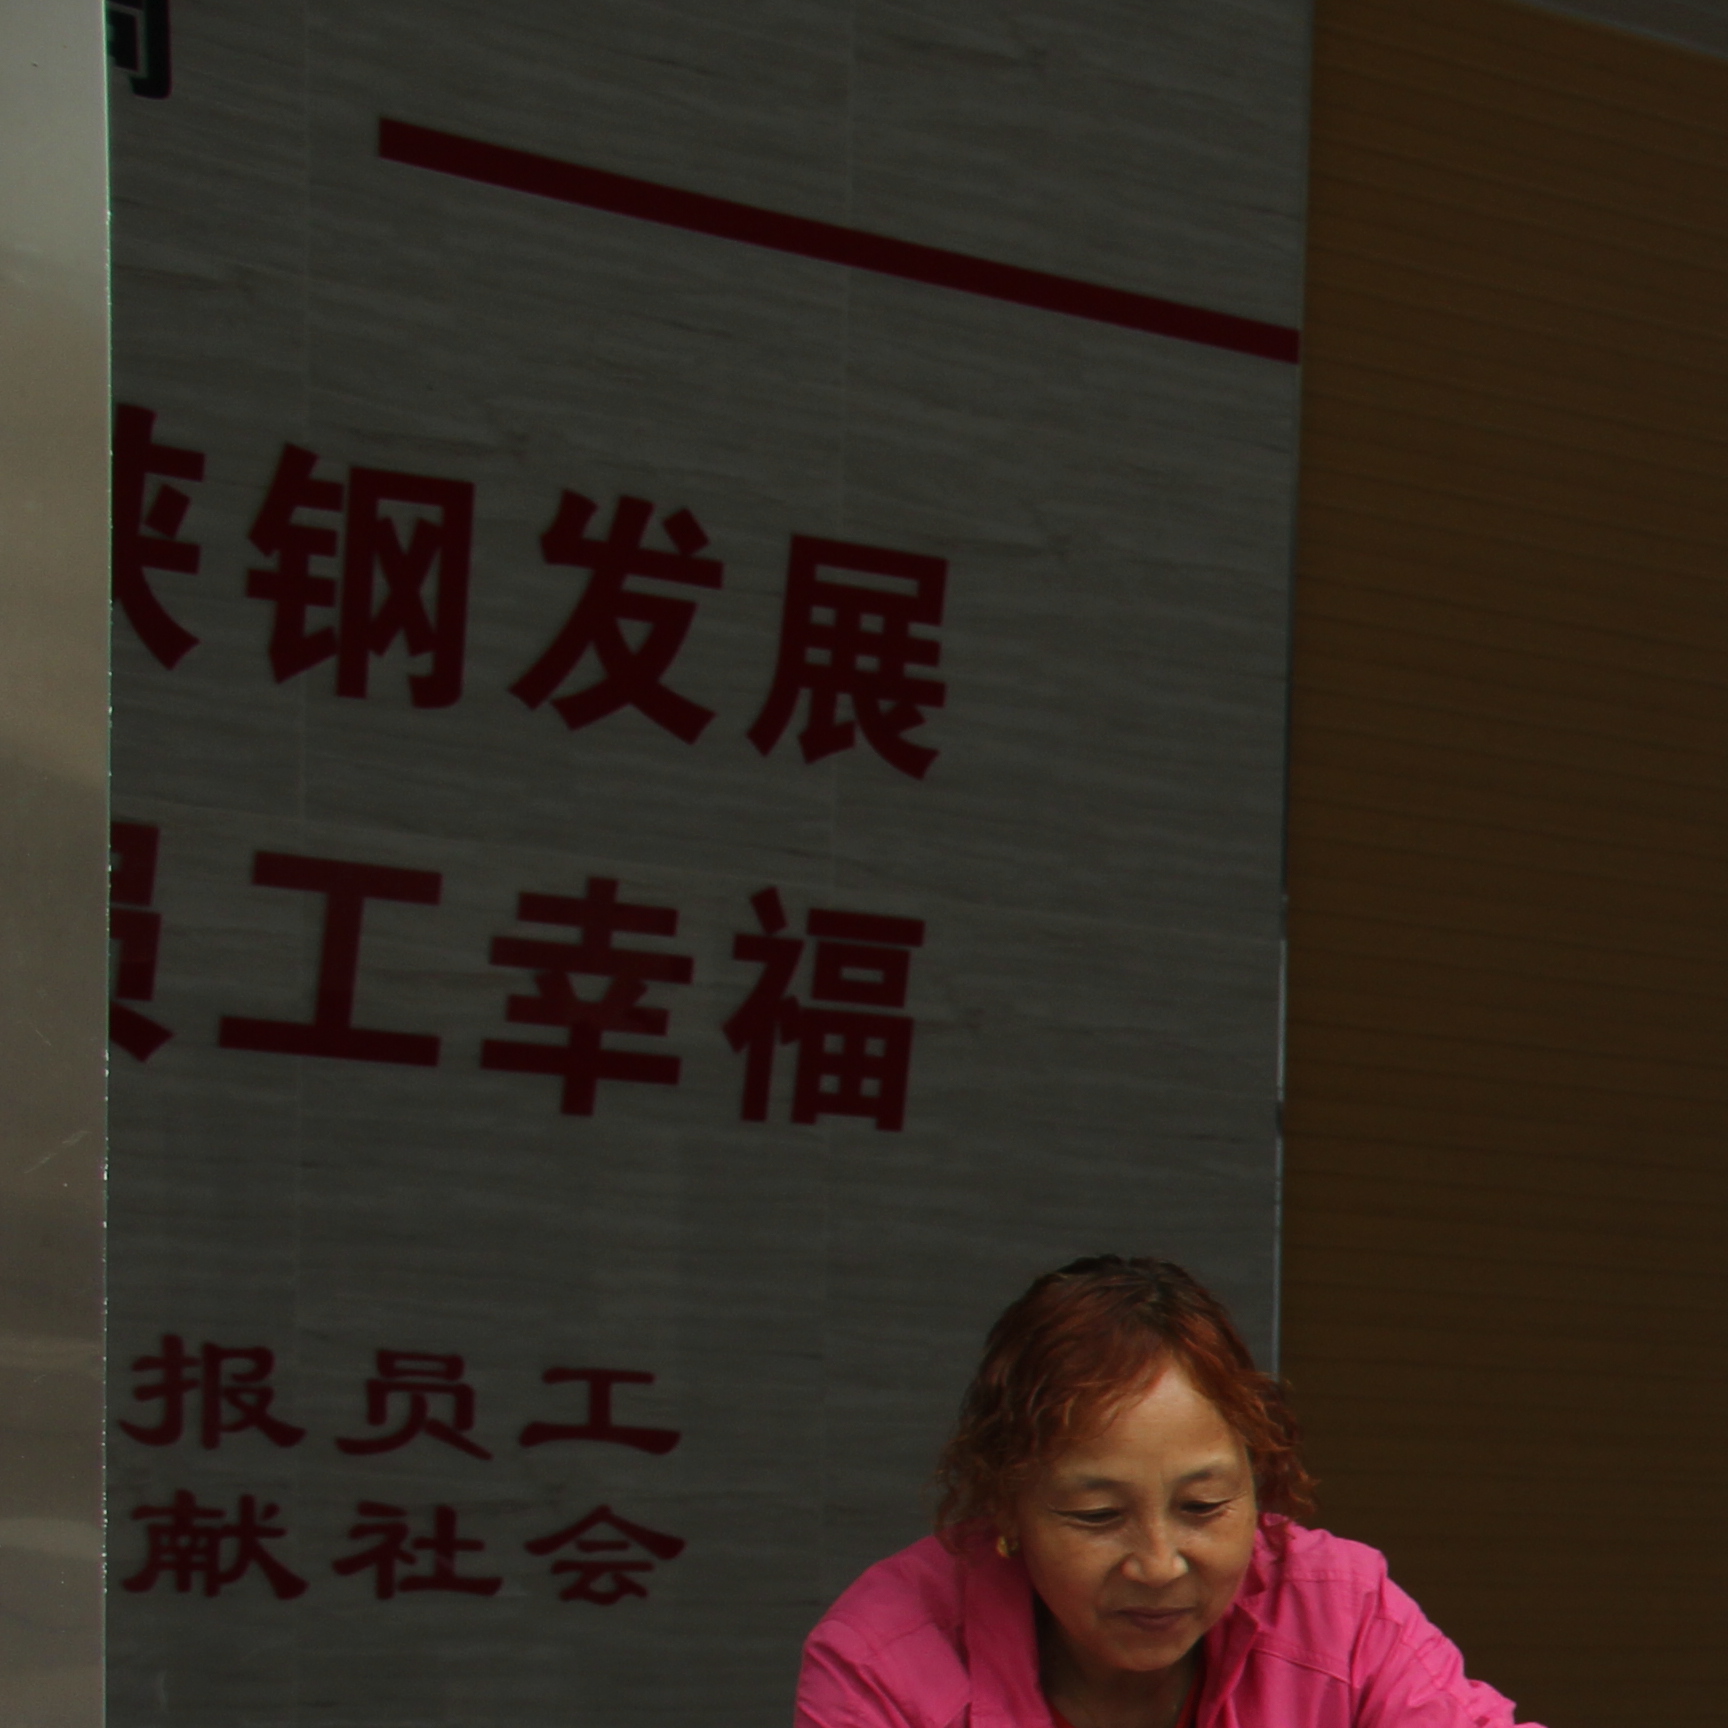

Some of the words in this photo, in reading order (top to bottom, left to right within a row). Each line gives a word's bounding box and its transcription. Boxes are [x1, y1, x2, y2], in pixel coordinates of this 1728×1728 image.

[118, 1333, 682, 1461] 报员工
[121, 1488, 686, 1607] 献社会
